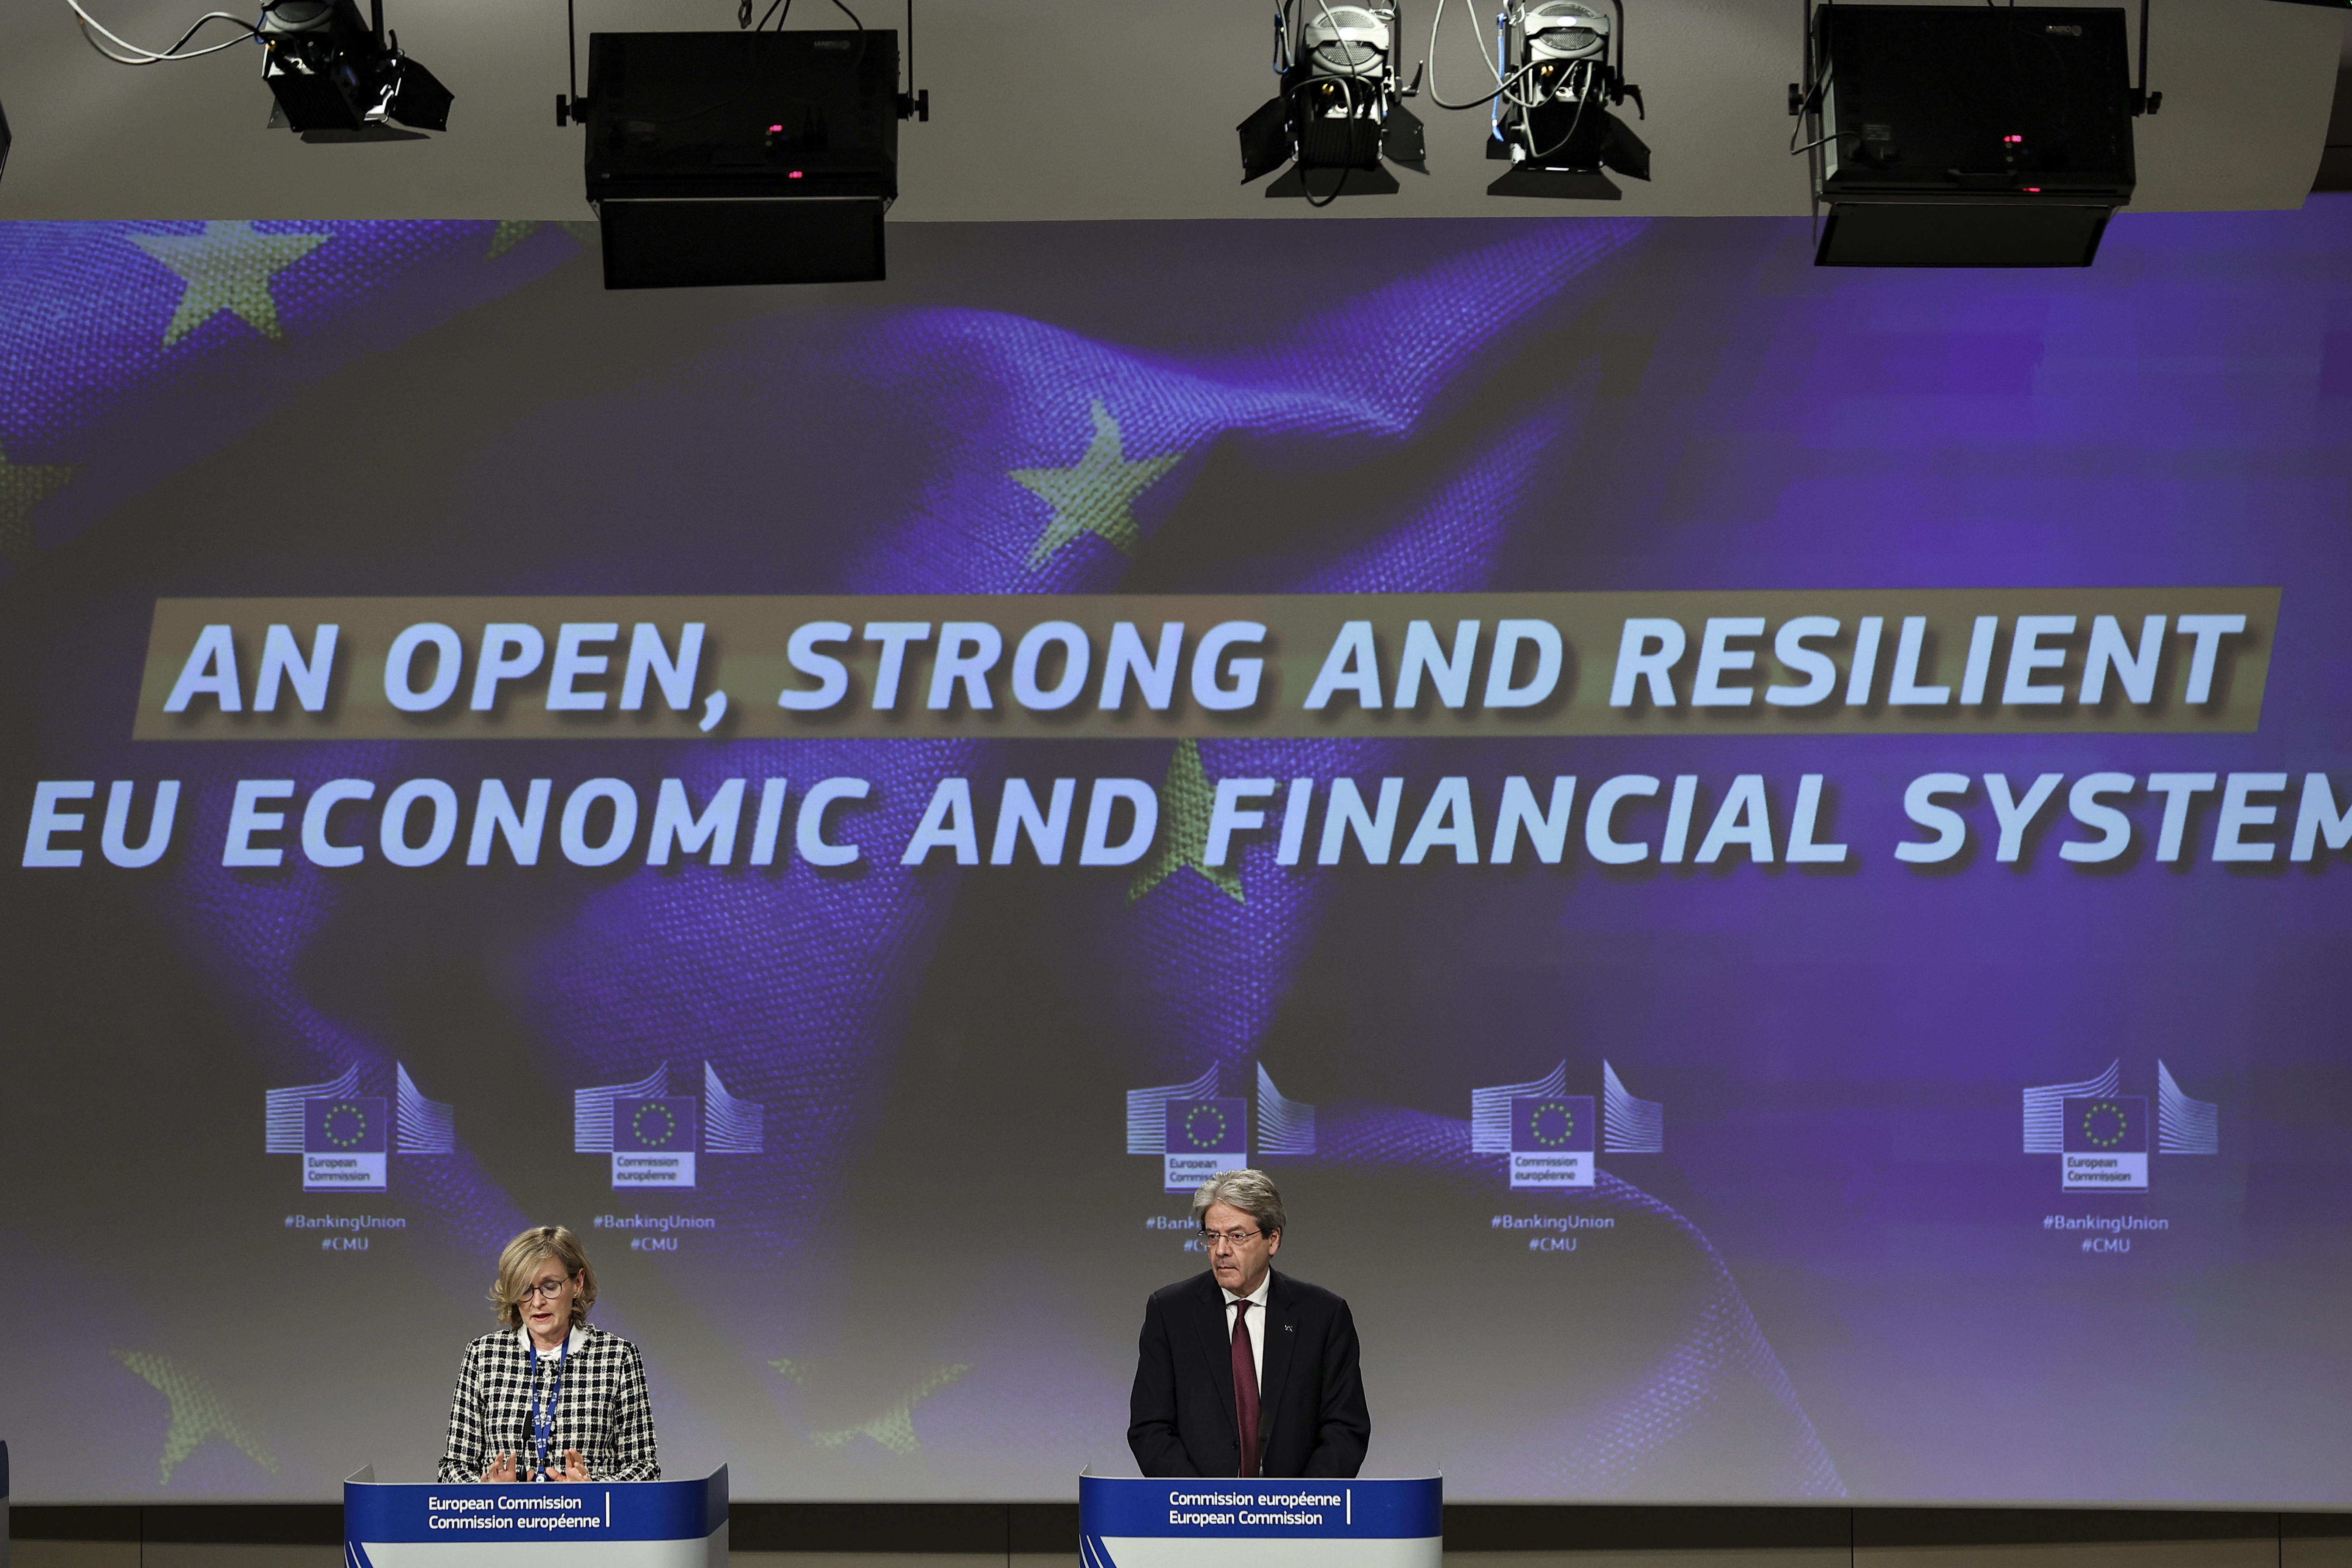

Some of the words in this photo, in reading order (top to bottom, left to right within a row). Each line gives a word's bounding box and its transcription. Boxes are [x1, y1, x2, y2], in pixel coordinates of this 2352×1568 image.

[164, 623, 338, 711] AN
[384, 622, 727, 732] OPEN,
[778, 621, 1267, 710] STRONG
[1303, 619, 1562, 709] AND
[1610, 615, 2246, 707] RESILIENT
[23, 781, 179, 867] EU
[223, 777, 869, 867] ECONOMIC
[901, 778, 1157, 866] AND
[1203, 774, 1847, 866] FINANCIAL
[1895, 772, 2352, 862] SYSTEM
[308, 1157, 357, 1170] European
[617, 1156, 679, 1167] Commission
[1169, 1158, 1217, 1170] European
[1515, 1156, 1578, 1167] Commission
[2067, 1156, 2118, 1170] European
[308, 1170, 370, 1182] Commission
[617, 1170, 676, 1182] européenne
[1514, 1170, 1576, 1182] européenne
[2067, 1170, 2131, 1182] Commission
[284, 1214, 406, 1232] #BankingUnion
[594, 1214, 715, 1232] #BankingUnion
[1491, 1214, 1614, 1232] #BankingUnion
[2043, 1215, 2168, 1233] #BankingUnion
[322, 1238, 369, 1251] #CMU
[631, 1238, 677, 1251] #CMU
[1529, 1238, 1576, 1251] #CMU
[2082, 1238, 2130, 1252] #CMU
[429, 1496, 494, 1513] European
[498, 1495, 581, 1510] Commission
[1169, 1491, 1253, 1506] Commission
[1258, 1491, 1341, 1508] européenne
[429, 1515, 513, 1529] Commission
[517, 1513, 600, 1532] européenne
[1170, 1510, 1235, 1527] European
[1239, 1510, 1322, 1525] Commission
